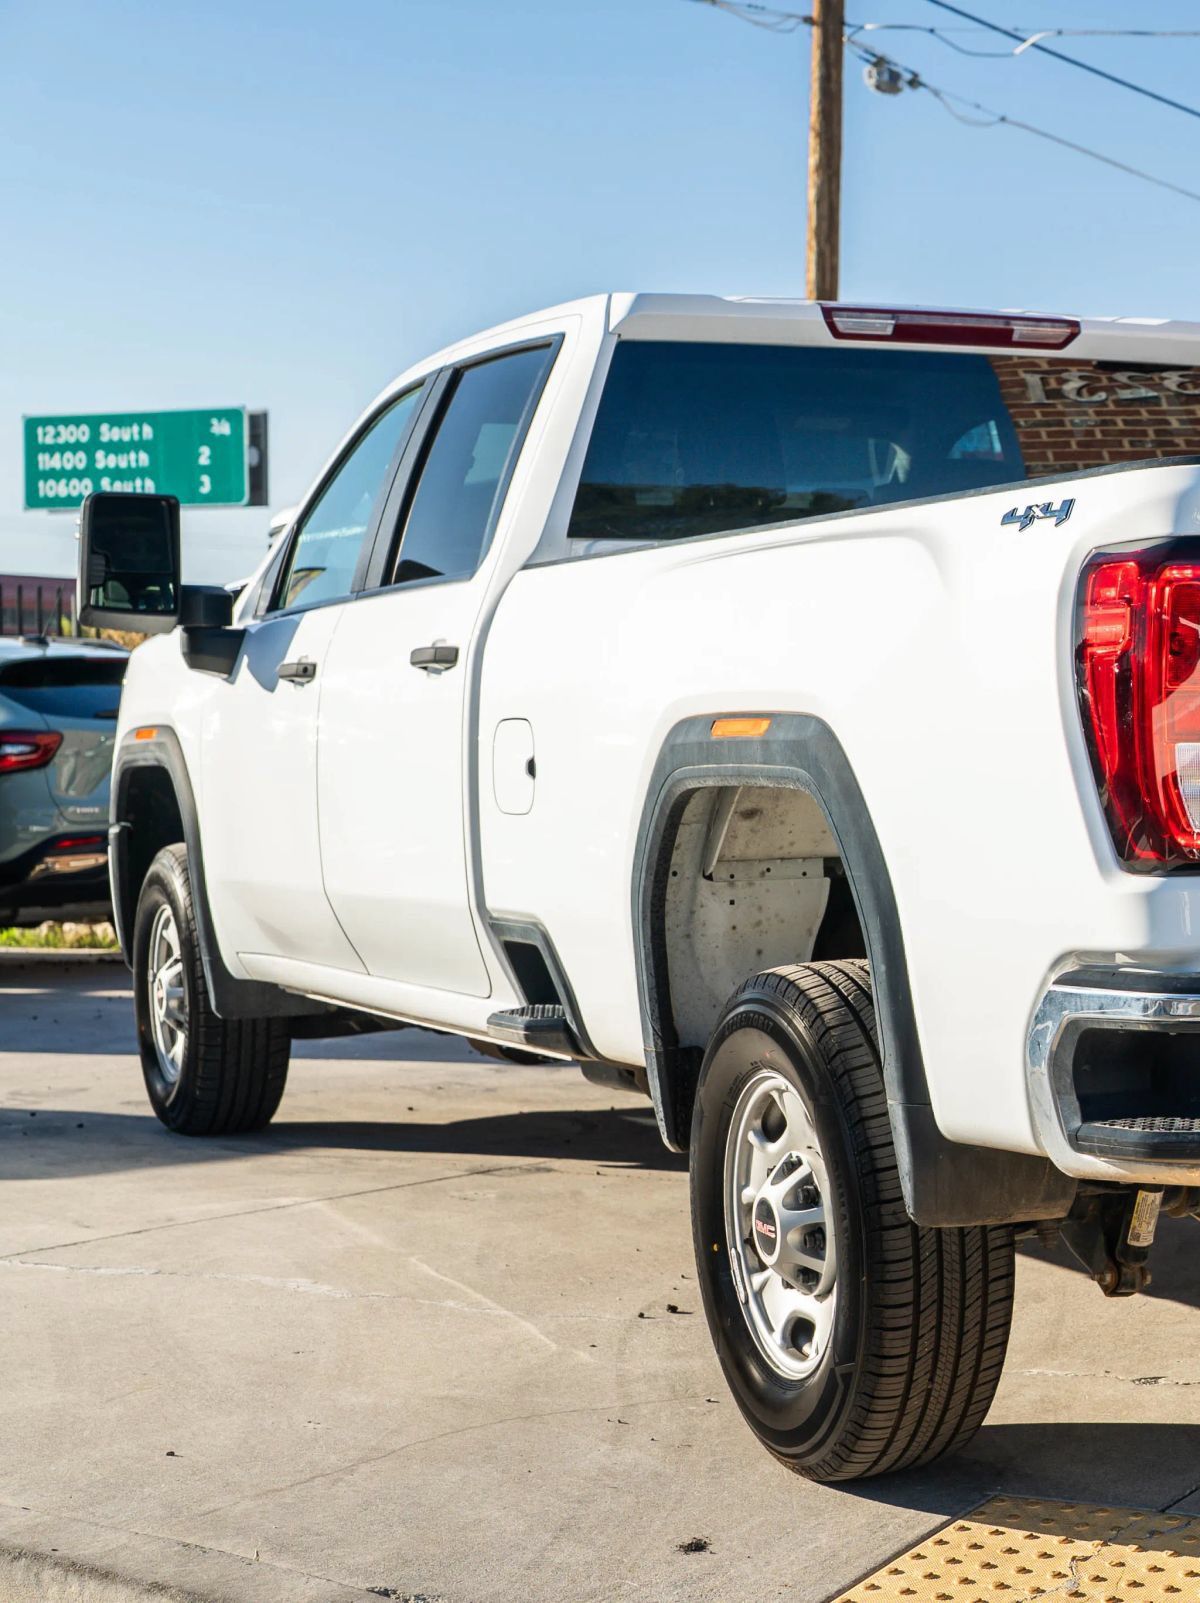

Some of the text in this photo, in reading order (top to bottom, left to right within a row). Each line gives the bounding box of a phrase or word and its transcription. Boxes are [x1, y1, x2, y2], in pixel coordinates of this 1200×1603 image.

[36, 424, 91, 445] 12300
[100, 422, 153, 443] South
[37, 446, 211, 471] 11400 South 2
[38, 474, 212, 498] 10600 South 3
